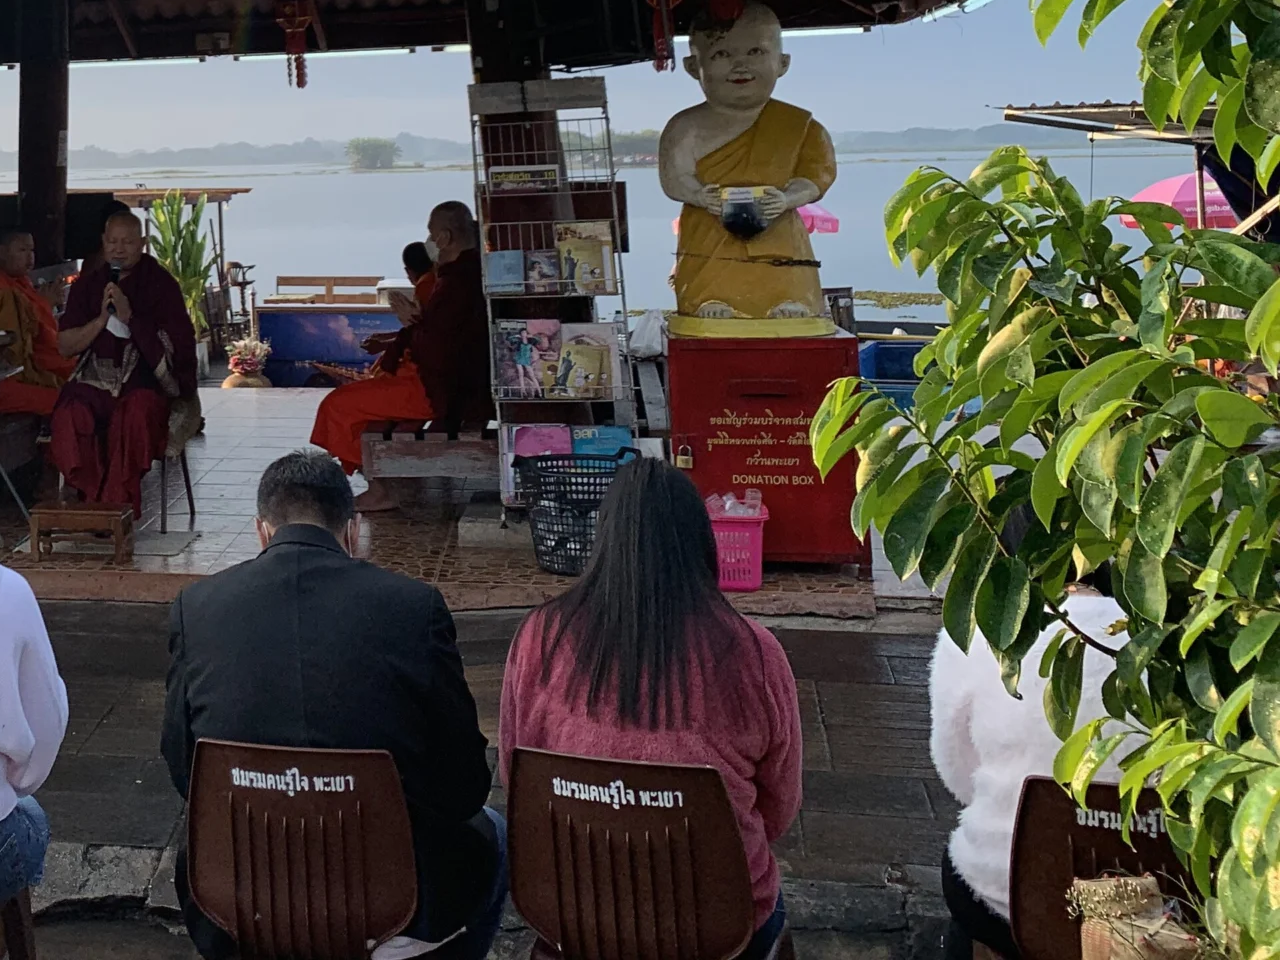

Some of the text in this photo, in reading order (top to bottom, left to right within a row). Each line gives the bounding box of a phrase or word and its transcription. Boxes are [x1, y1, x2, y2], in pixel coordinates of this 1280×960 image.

[732, 474, 815, 485] DONATION BOX
[231, 767, 354, 797] ชมรมคนรู้ใจ พะเยา
[552, 776, 683, 810] ชมรมคนรู้ใจ พะเยา
